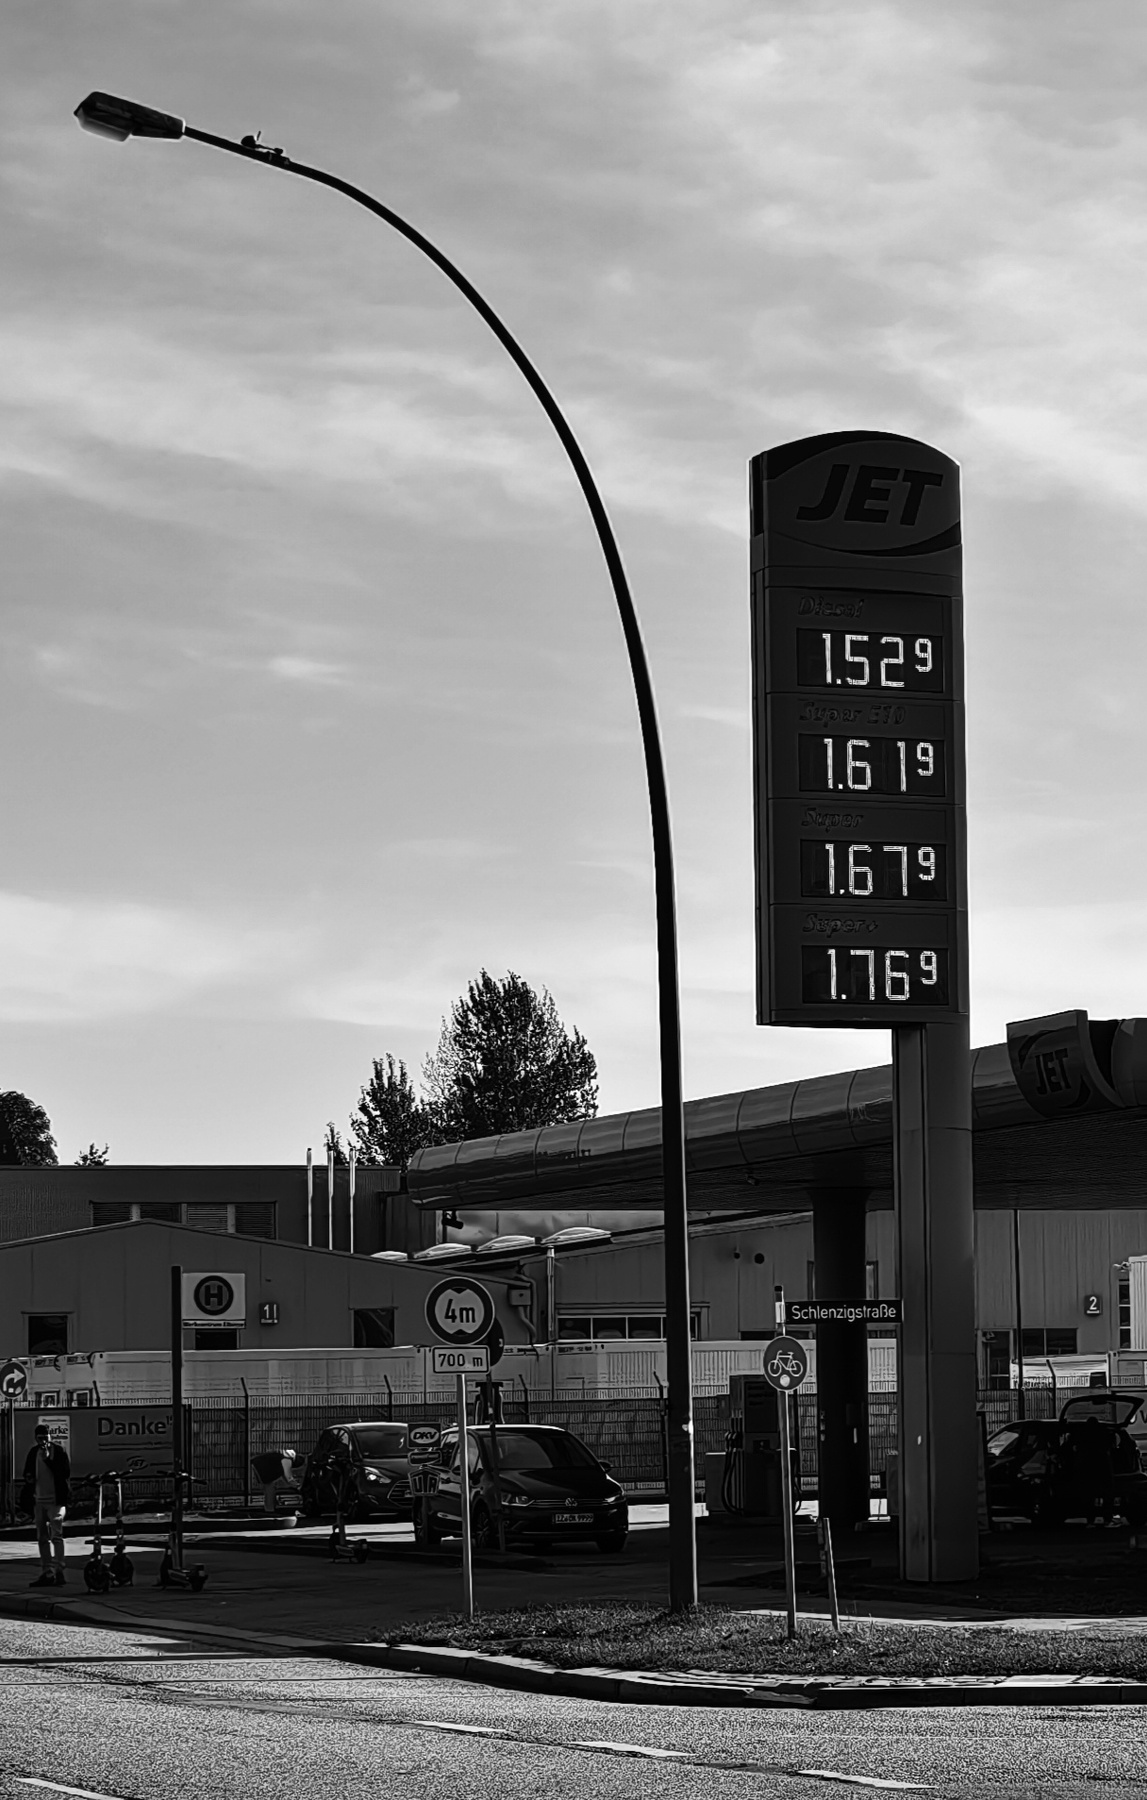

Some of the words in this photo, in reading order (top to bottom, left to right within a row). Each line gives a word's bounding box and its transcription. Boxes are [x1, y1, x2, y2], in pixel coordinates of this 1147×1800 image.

[796, 463, 944, 526] JET
[798, 596, 864, 618] Diesel
[799, 702, 862, 728] Super
[867, 704, 906, 725] E10
[801, 807, 864, 832] Super
[1035, 1048, 1072, 1095] JET
[204, 1284, 223, 1306] H
[1089, 1296, 1098, 1310] 2
[791, 1302, 897, 1322] Schlenzigstraße
[438, 1353, 466, 1368] 700
[472, 1356, 483, 1368] m
[413, 1431, 437, 1440] DKV
[411, 1470, 439, 1493] UTA
